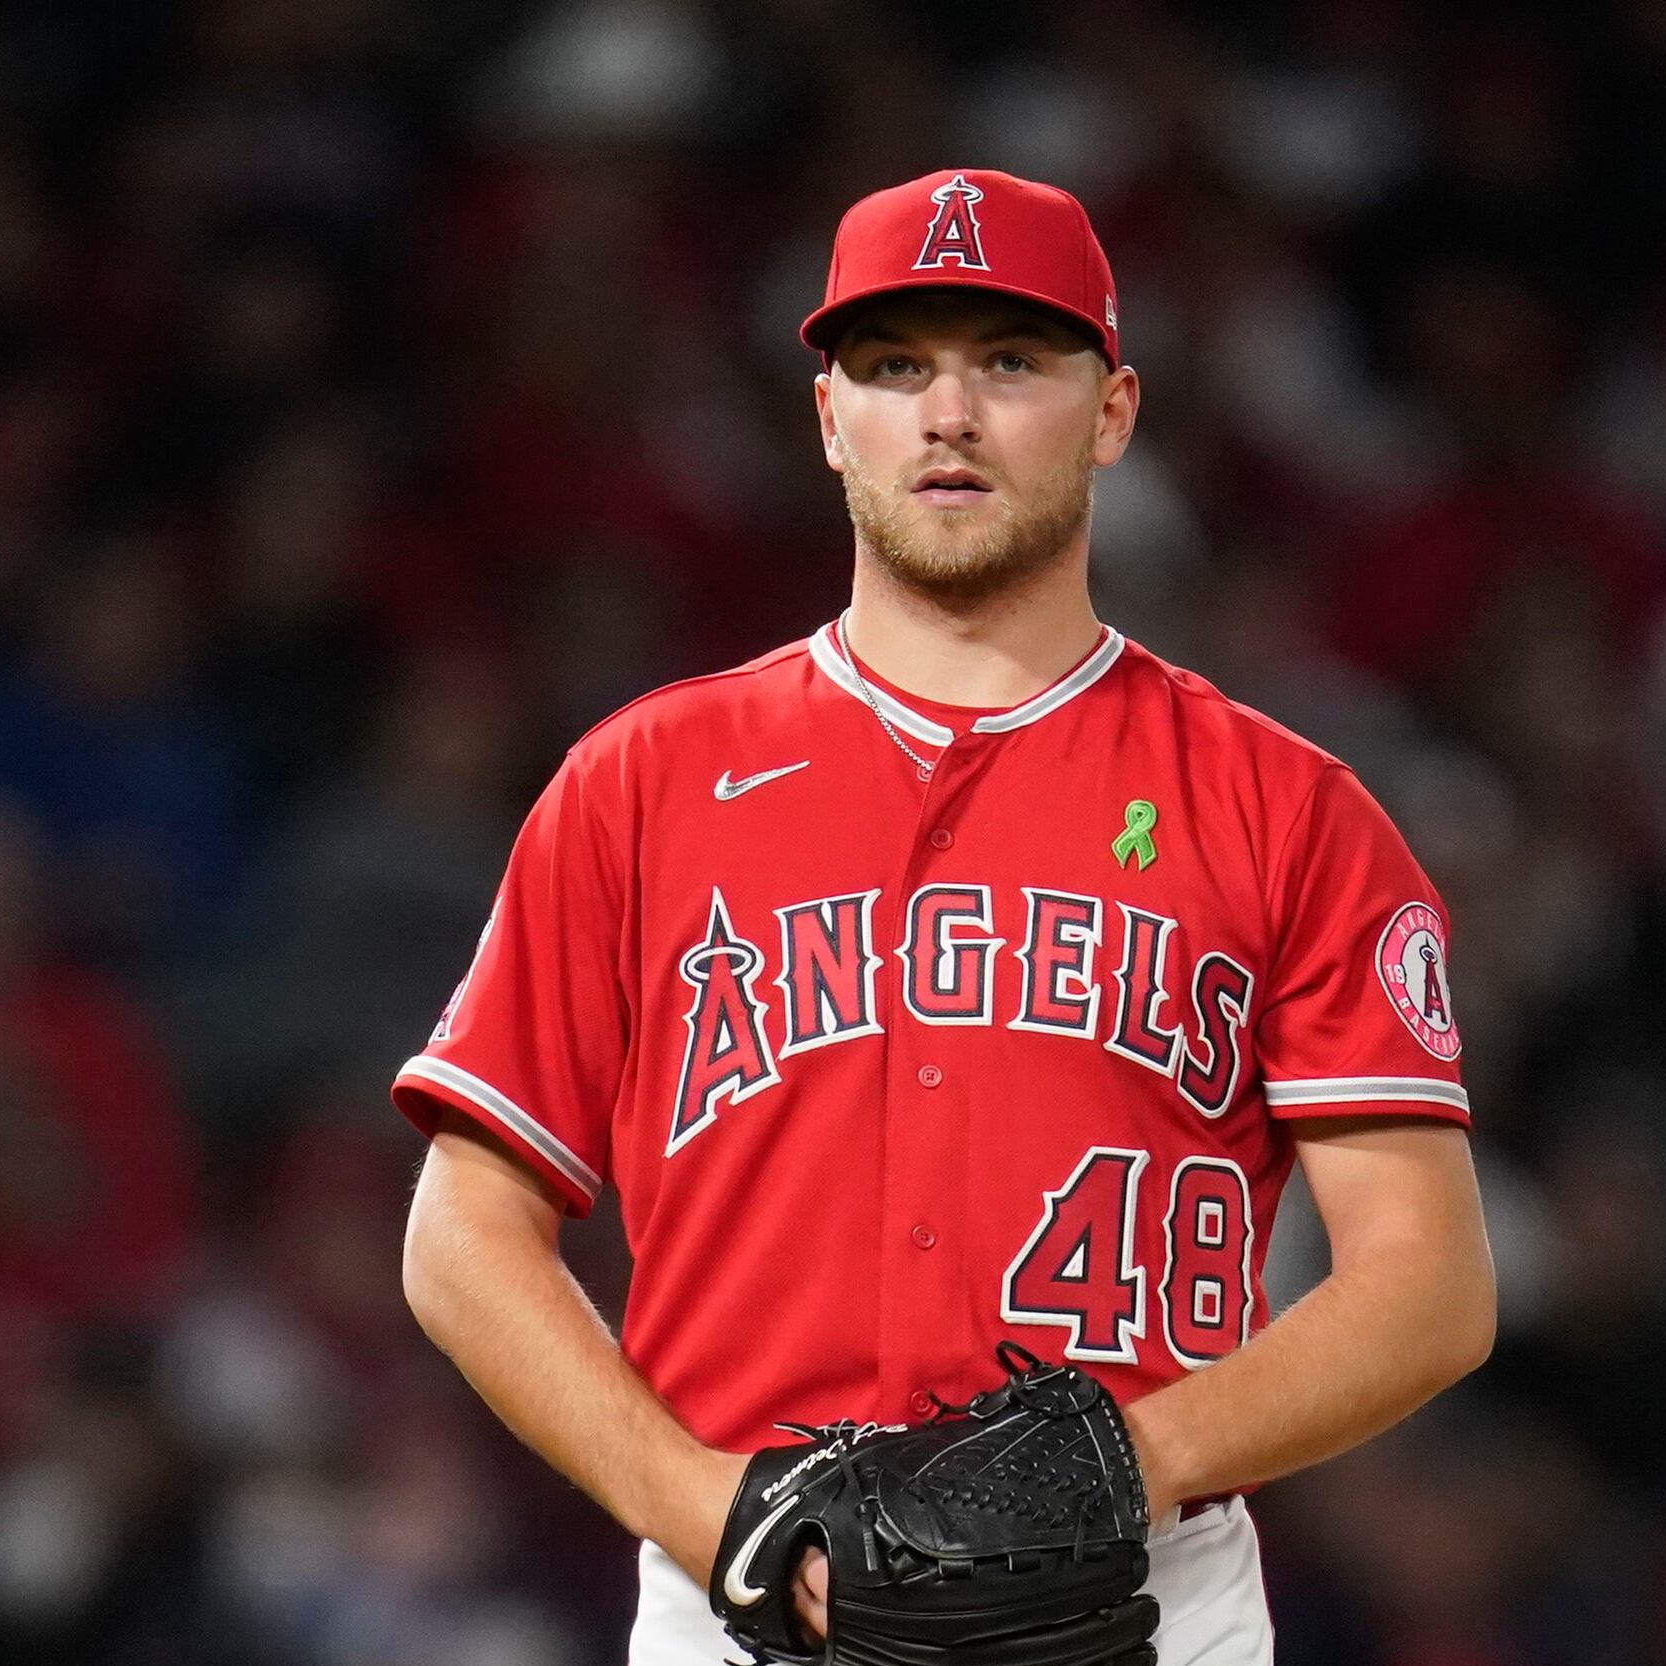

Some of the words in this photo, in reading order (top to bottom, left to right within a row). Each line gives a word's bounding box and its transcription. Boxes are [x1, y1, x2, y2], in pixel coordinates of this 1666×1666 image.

[911, 174, 992, 272] A
[1396, 908, 1446, 952] ANGEL
[662, 883, 1255, 1159] ANGELS
[999, 1146, 1255, 1371] 48
